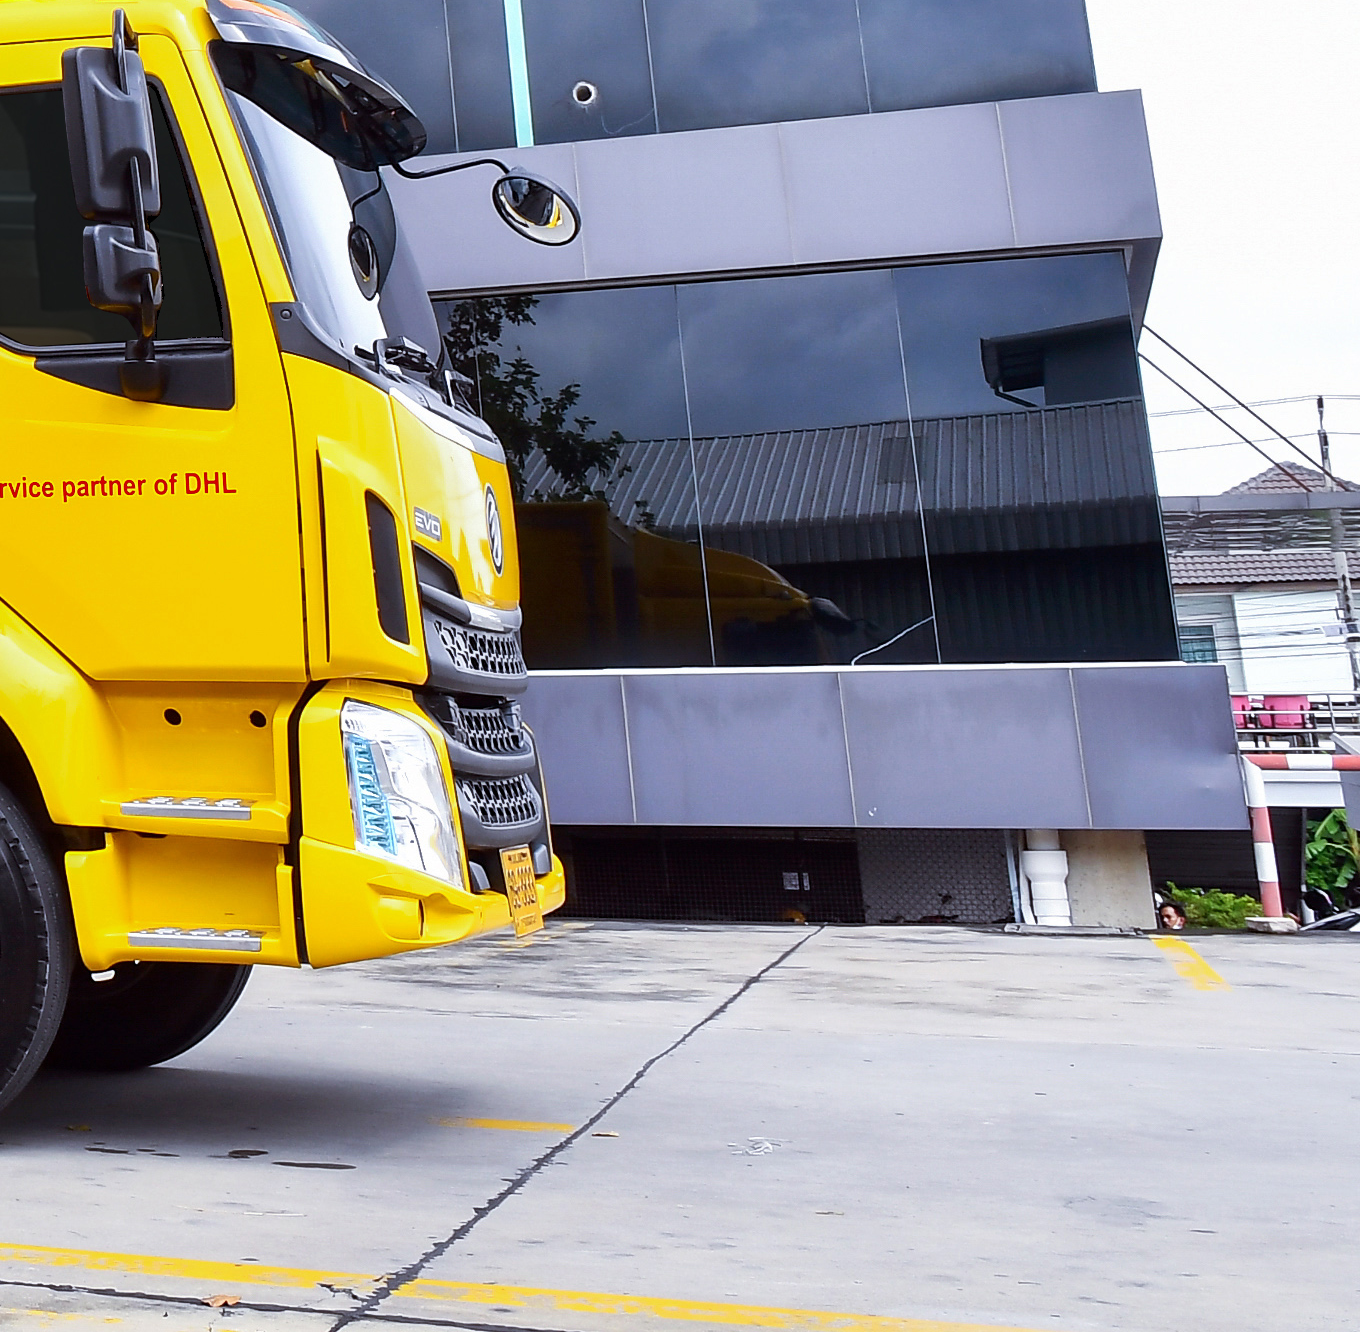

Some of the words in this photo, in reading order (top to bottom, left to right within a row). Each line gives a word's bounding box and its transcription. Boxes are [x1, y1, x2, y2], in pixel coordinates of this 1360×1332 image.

[62, 475, 147, 503] partner
[153, 472, 178, 496] of
[184, 471, 237, 495] DHL
